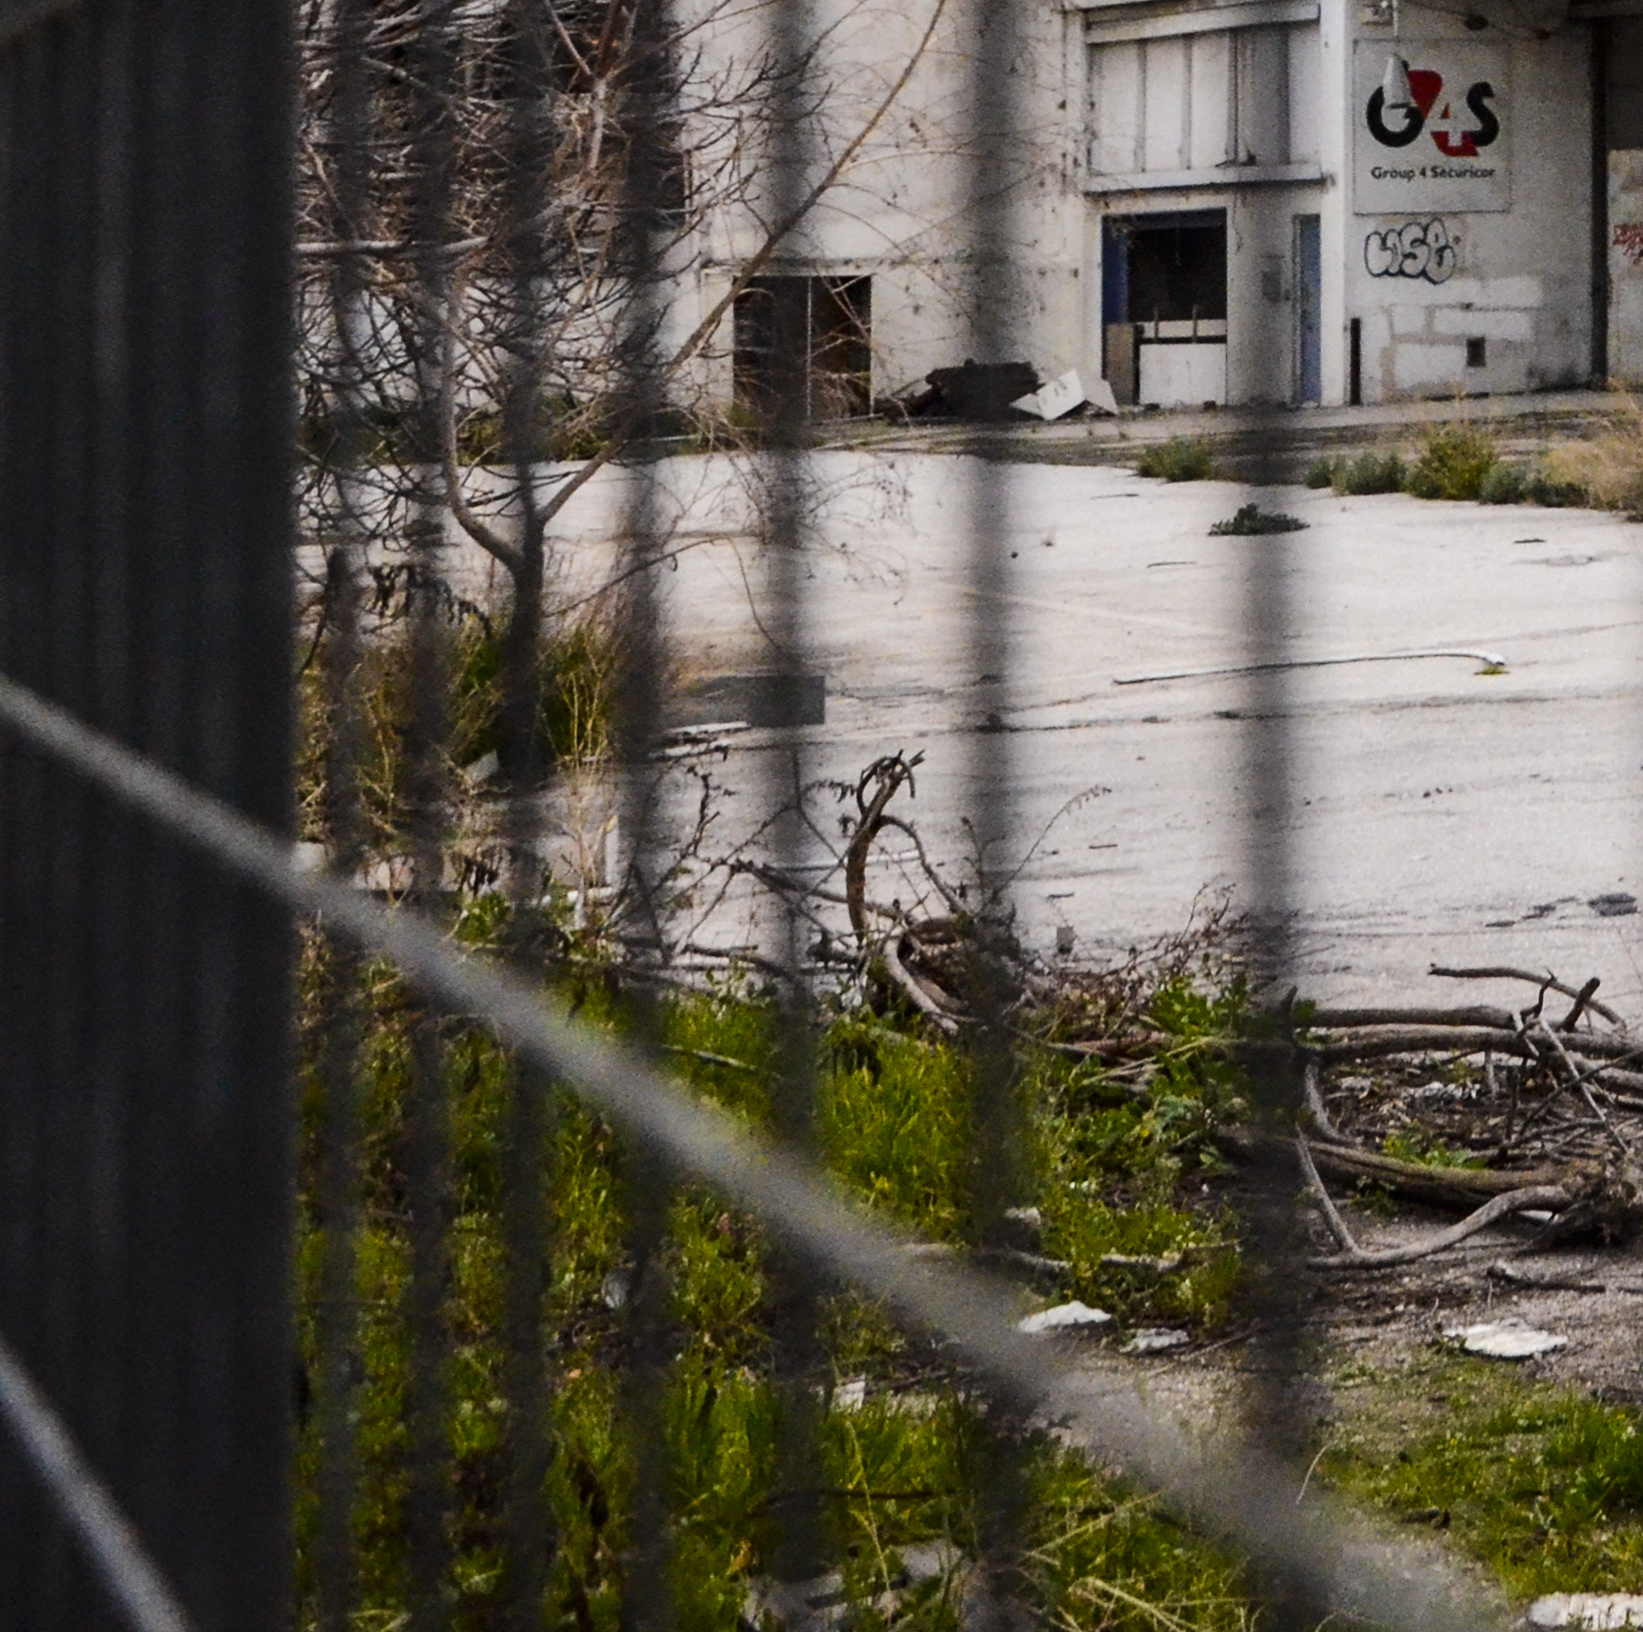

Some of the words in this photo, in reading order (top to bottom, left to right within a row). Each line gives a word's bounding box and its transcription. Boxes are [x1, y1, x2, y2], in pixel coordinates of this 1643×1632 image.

[1371, 166, 1415, 183] Group
[1420, 166, 1427, 179] 4
[1430, 165, 1496, 180] Securicor
